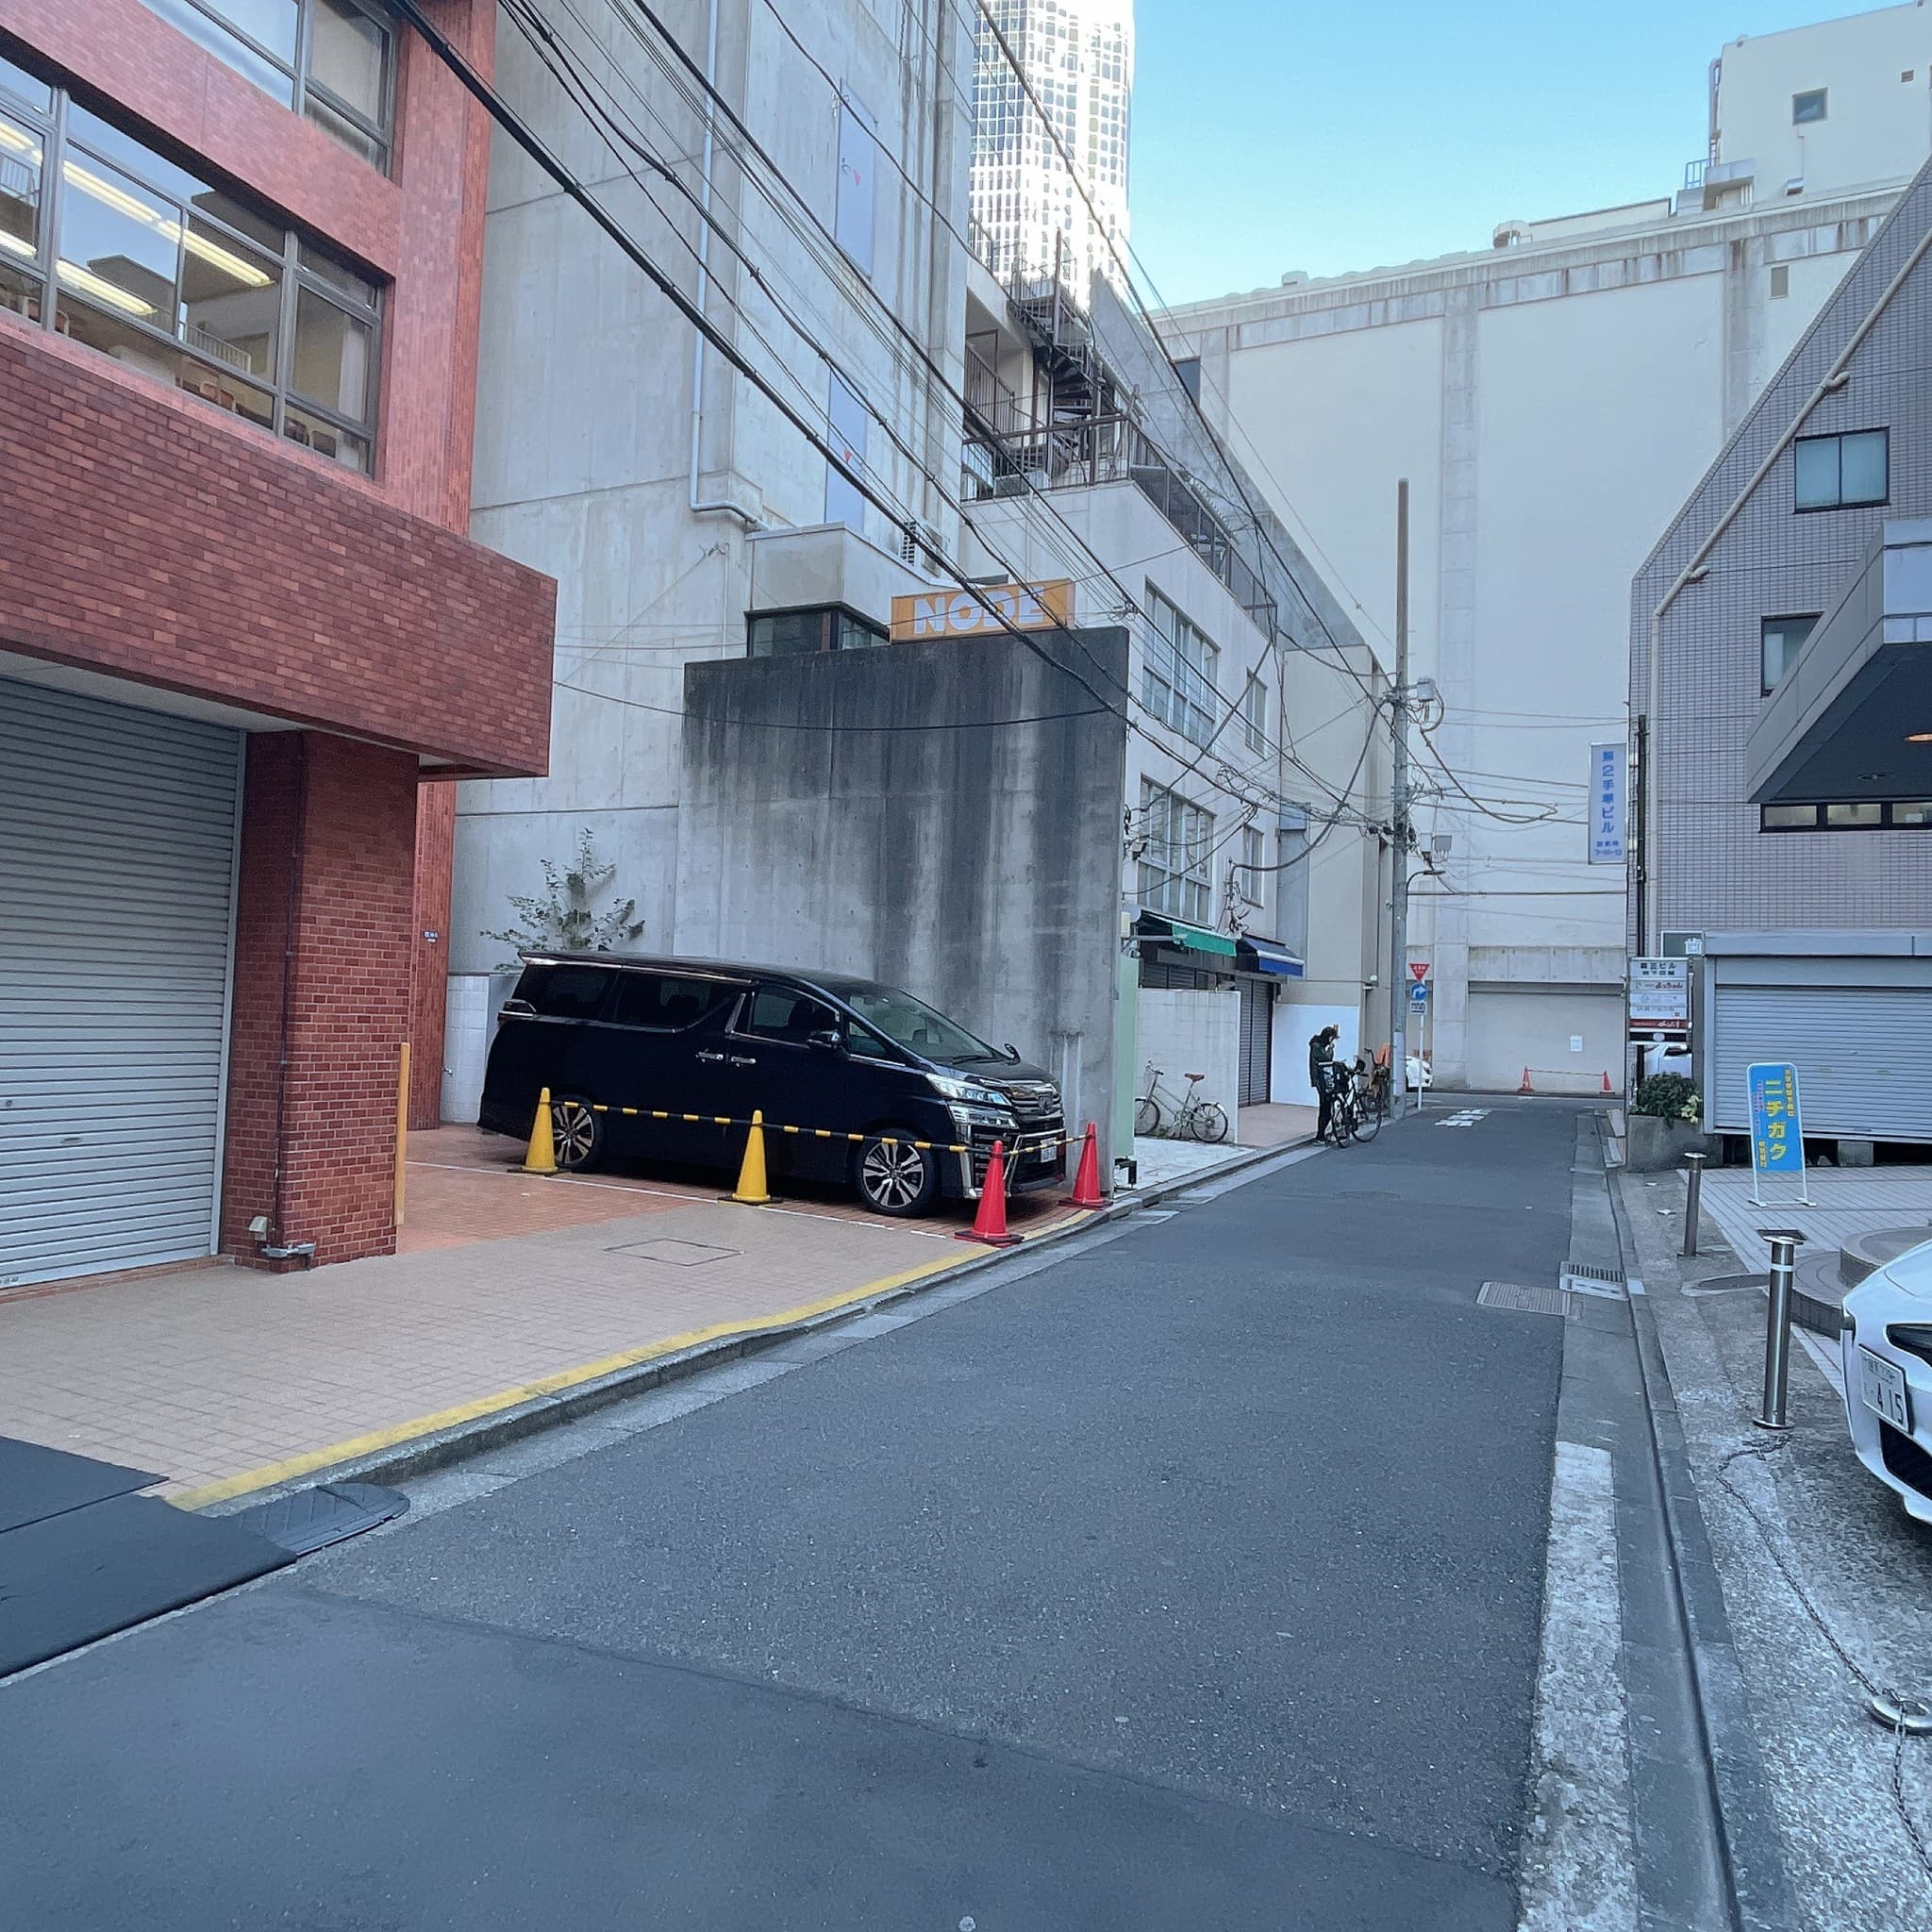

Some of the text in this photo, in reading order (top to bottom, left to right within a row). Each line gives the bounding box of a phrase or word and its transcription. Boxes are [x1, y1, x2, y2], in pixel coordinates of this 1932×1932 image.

[914, 587, 1045, 635] NODE
[1764, 1079, 1787, 1161] ニチガク
